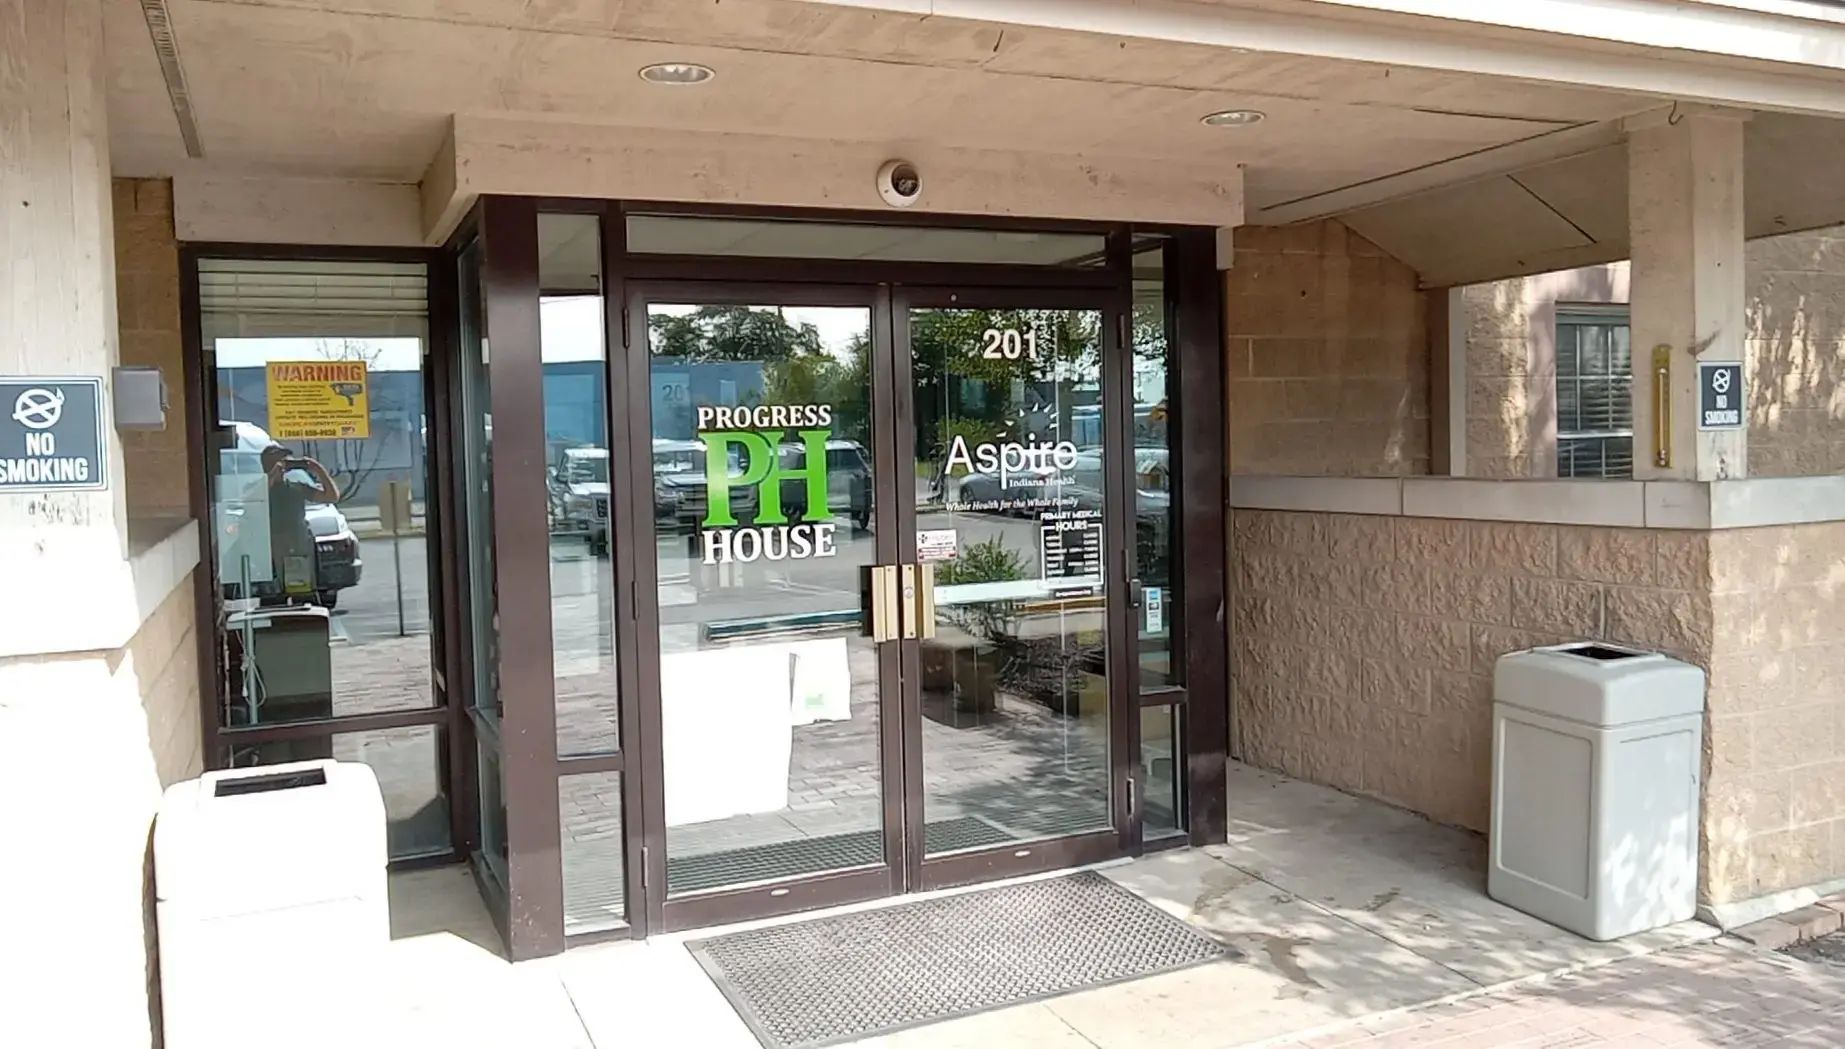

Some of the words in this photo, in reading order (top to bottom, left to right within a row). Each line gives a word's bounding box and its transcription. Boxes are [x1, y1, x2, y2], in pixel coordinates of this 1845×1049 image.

[983, 329, 1037, 359] 201
[272, 364, 362, 382] WARNING
[1716, 395, 1727, 408] NO
[697, 405, 832, 429] PROGRESS
[1705, 410, 1738, 424] SMOKING
[26, 432, 55, 456] NO
[0, 457, 88, 483] SMOKING
[945, 433, 1078, 490] Aspire
[698, 430, 834, 527] PH
[1009, 479, 1044, 488] Indiana
[946, 502, 971, 512] Whole
[972, 500, 998, 511] Health
[999, 500, 1012, 511] for
[1013, 499, 1026, 508] the
[1027, 498, 1051, 508] Whole
[1051, 497, 1079, 508] Family
[1072, 510, 1102, 519] MEDICAL
[1055, 520, 1088, 531] HOURS
[702, 523, 837, 565] HOUSE
